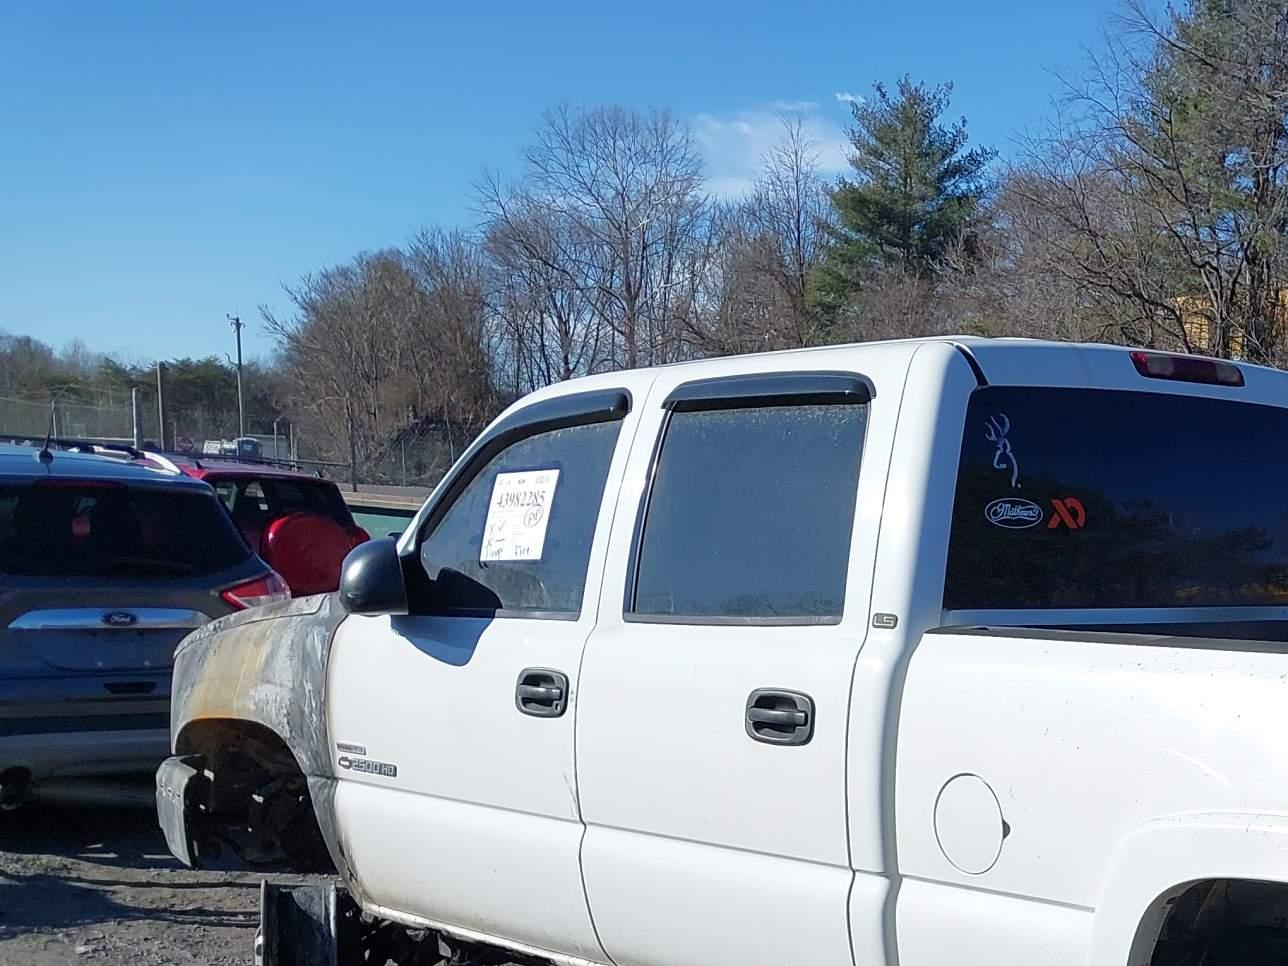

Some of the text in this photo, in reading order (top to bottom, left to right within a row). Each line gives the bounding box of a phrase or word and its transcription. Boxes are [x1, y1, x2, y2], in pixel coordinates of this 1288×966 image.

[496, 490, 546, 508] 43982285
[873, 615, 895, 627] LS
[351, 758, 380, 773] 2500
